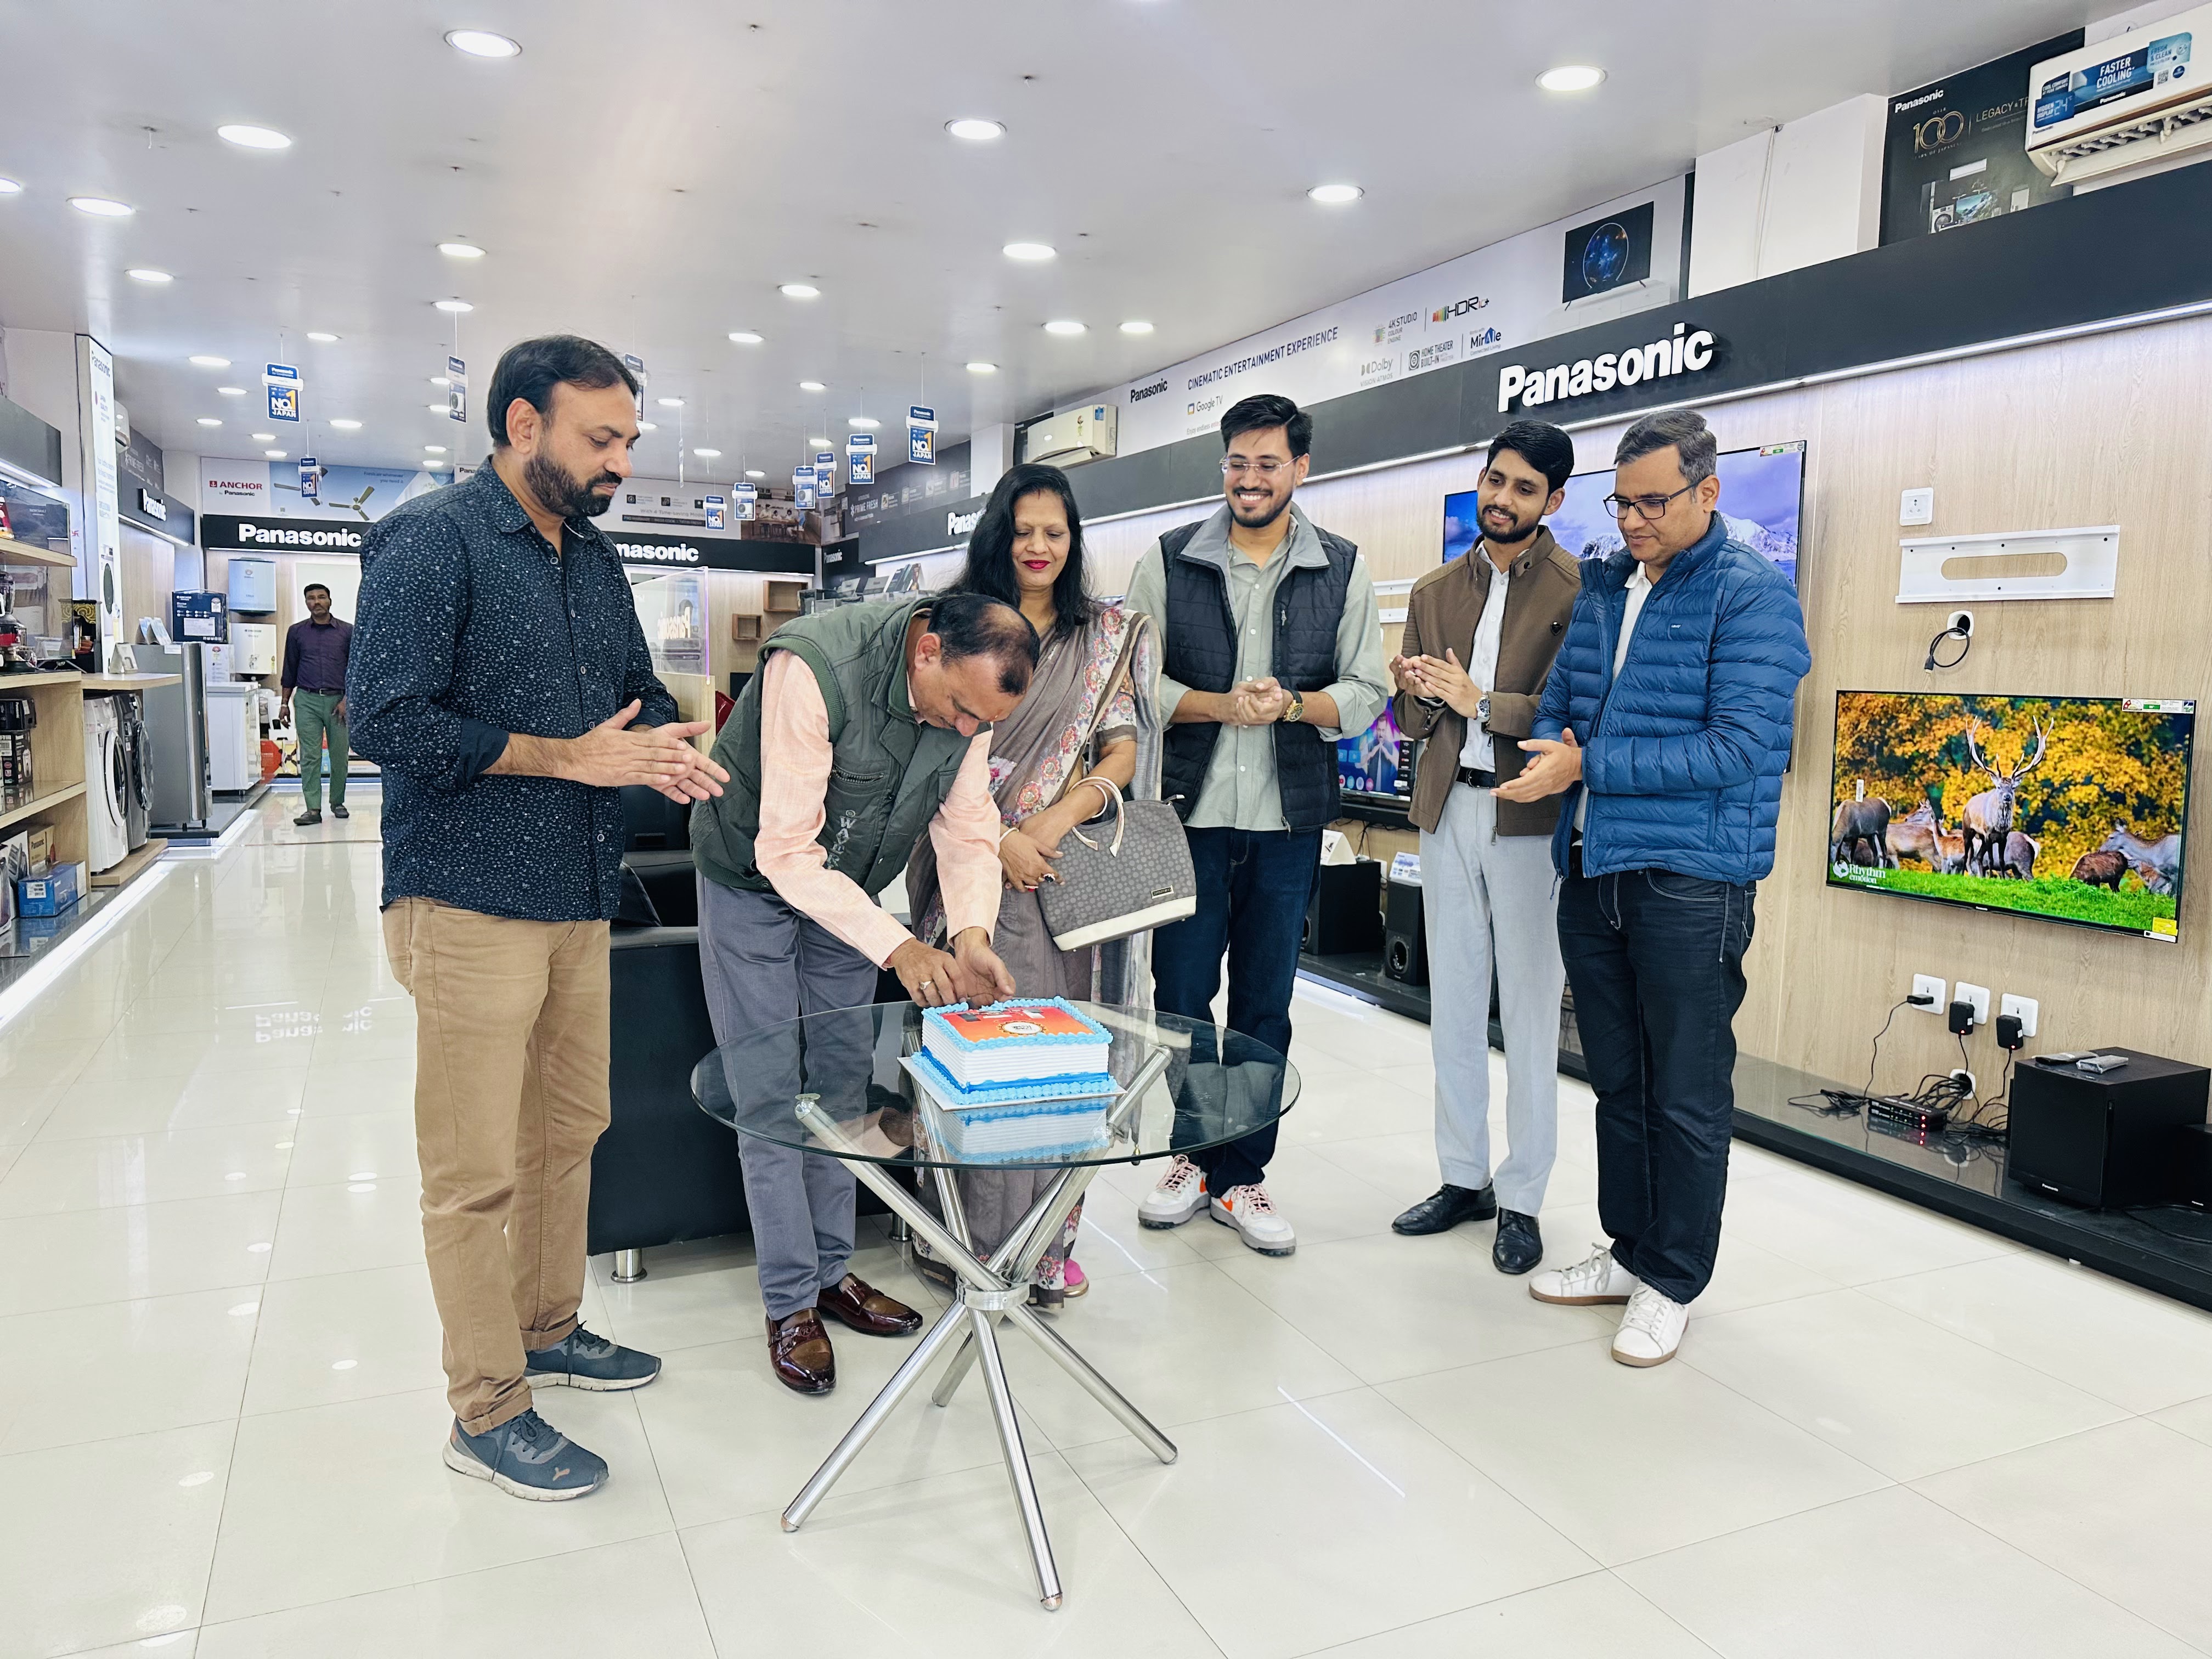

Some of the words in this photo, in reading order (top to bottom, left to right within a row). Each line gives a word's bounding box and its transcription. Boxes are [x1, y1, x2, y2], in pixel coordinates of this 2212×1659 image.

[2100, 57, 2131, 77] FASTER
[1894, 89, 1944, 114] Panasonic
[1976, 101, 2013, 122] LEGACY
[1913, 111, 1964, 153] 100
[1396, 312, 1418, 327] STUDIO
[1434, 340, 1453, 353] THEATER
[1188, 368, 1223, 391] CINEMATIC
[1224, 346, 1285, 378] ENTERTAINMENT
[1286, 326, 1338, 357] EXPERIENCE
[1371, 358, 1393, 374] Dolby
[1497, 322, 1714, 413] Panasonic
[1130, 378, 1168, 403] Panasonic
[1197, 397, 1215, 412] Google
[1216, 394, 1223, 405] TV
[272, 409, 296, 418] JAPAN
[912, 452, 932, 460] JAPAN
[219, 481, 262, 490] ANCHOR
[143, 488, 166, 522] Panasonic
[239, 523, 362, 548] Panasonic
[616, 543, 699, 562] nasonic
[823, 549, 843, 565] Panasonic
[1849, 864, 1886, 878] Rhythm
